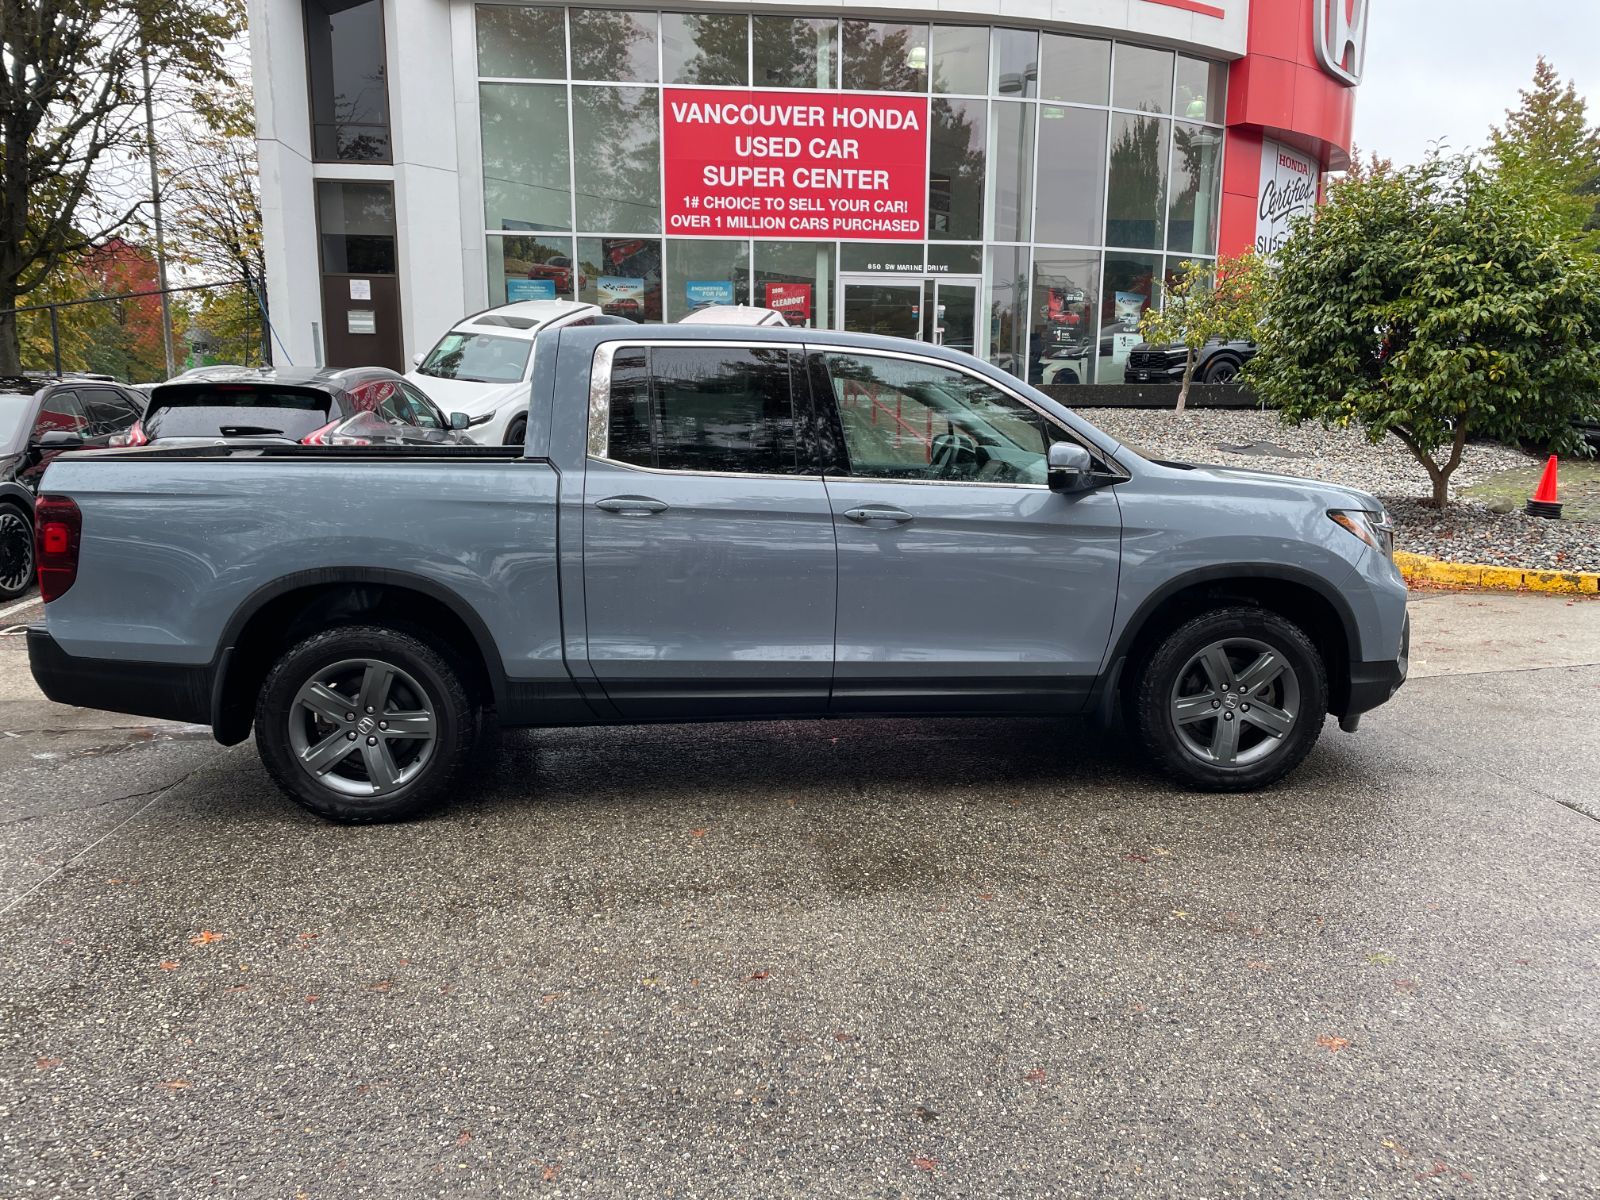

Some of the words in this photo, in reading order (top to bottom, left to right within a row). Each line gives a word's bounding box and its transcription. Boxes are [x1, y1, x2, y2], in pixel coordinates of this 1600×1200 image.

[670, 101, 825, 127] VANCOUVER
[832, 106, 920, 131] HONDA
[735, 135, 802, 158] USED
[808, 137, 859, 160] CAR
[1279, 154, 1308, 176] HONDA
[702, 165, 785, 188] SUPER
[792, 167, 889, 191] CENTER
[683, 195, 699, 209] 1#
[703, 195, 761, 210] CHOICE
[764, 197, 785, 211] TO
[788, 197, 826, 212] SELL
[828, 198, 870, 212] YOUR
[873, 199, 908, 214] CAR!
[1260, 172, 1314, 221] Certified
[670, 214, 711, 228] OVER
[714, 215, 721, 228] 1
[726, 215, 786, 230] MILLION
[789, 216, 829, 231] CARS
[832, 217, 920, 232] PURCHASED
[927, 264, 949, 272] DRIVE
[771, 295, 805, 308] CLEAROUT
